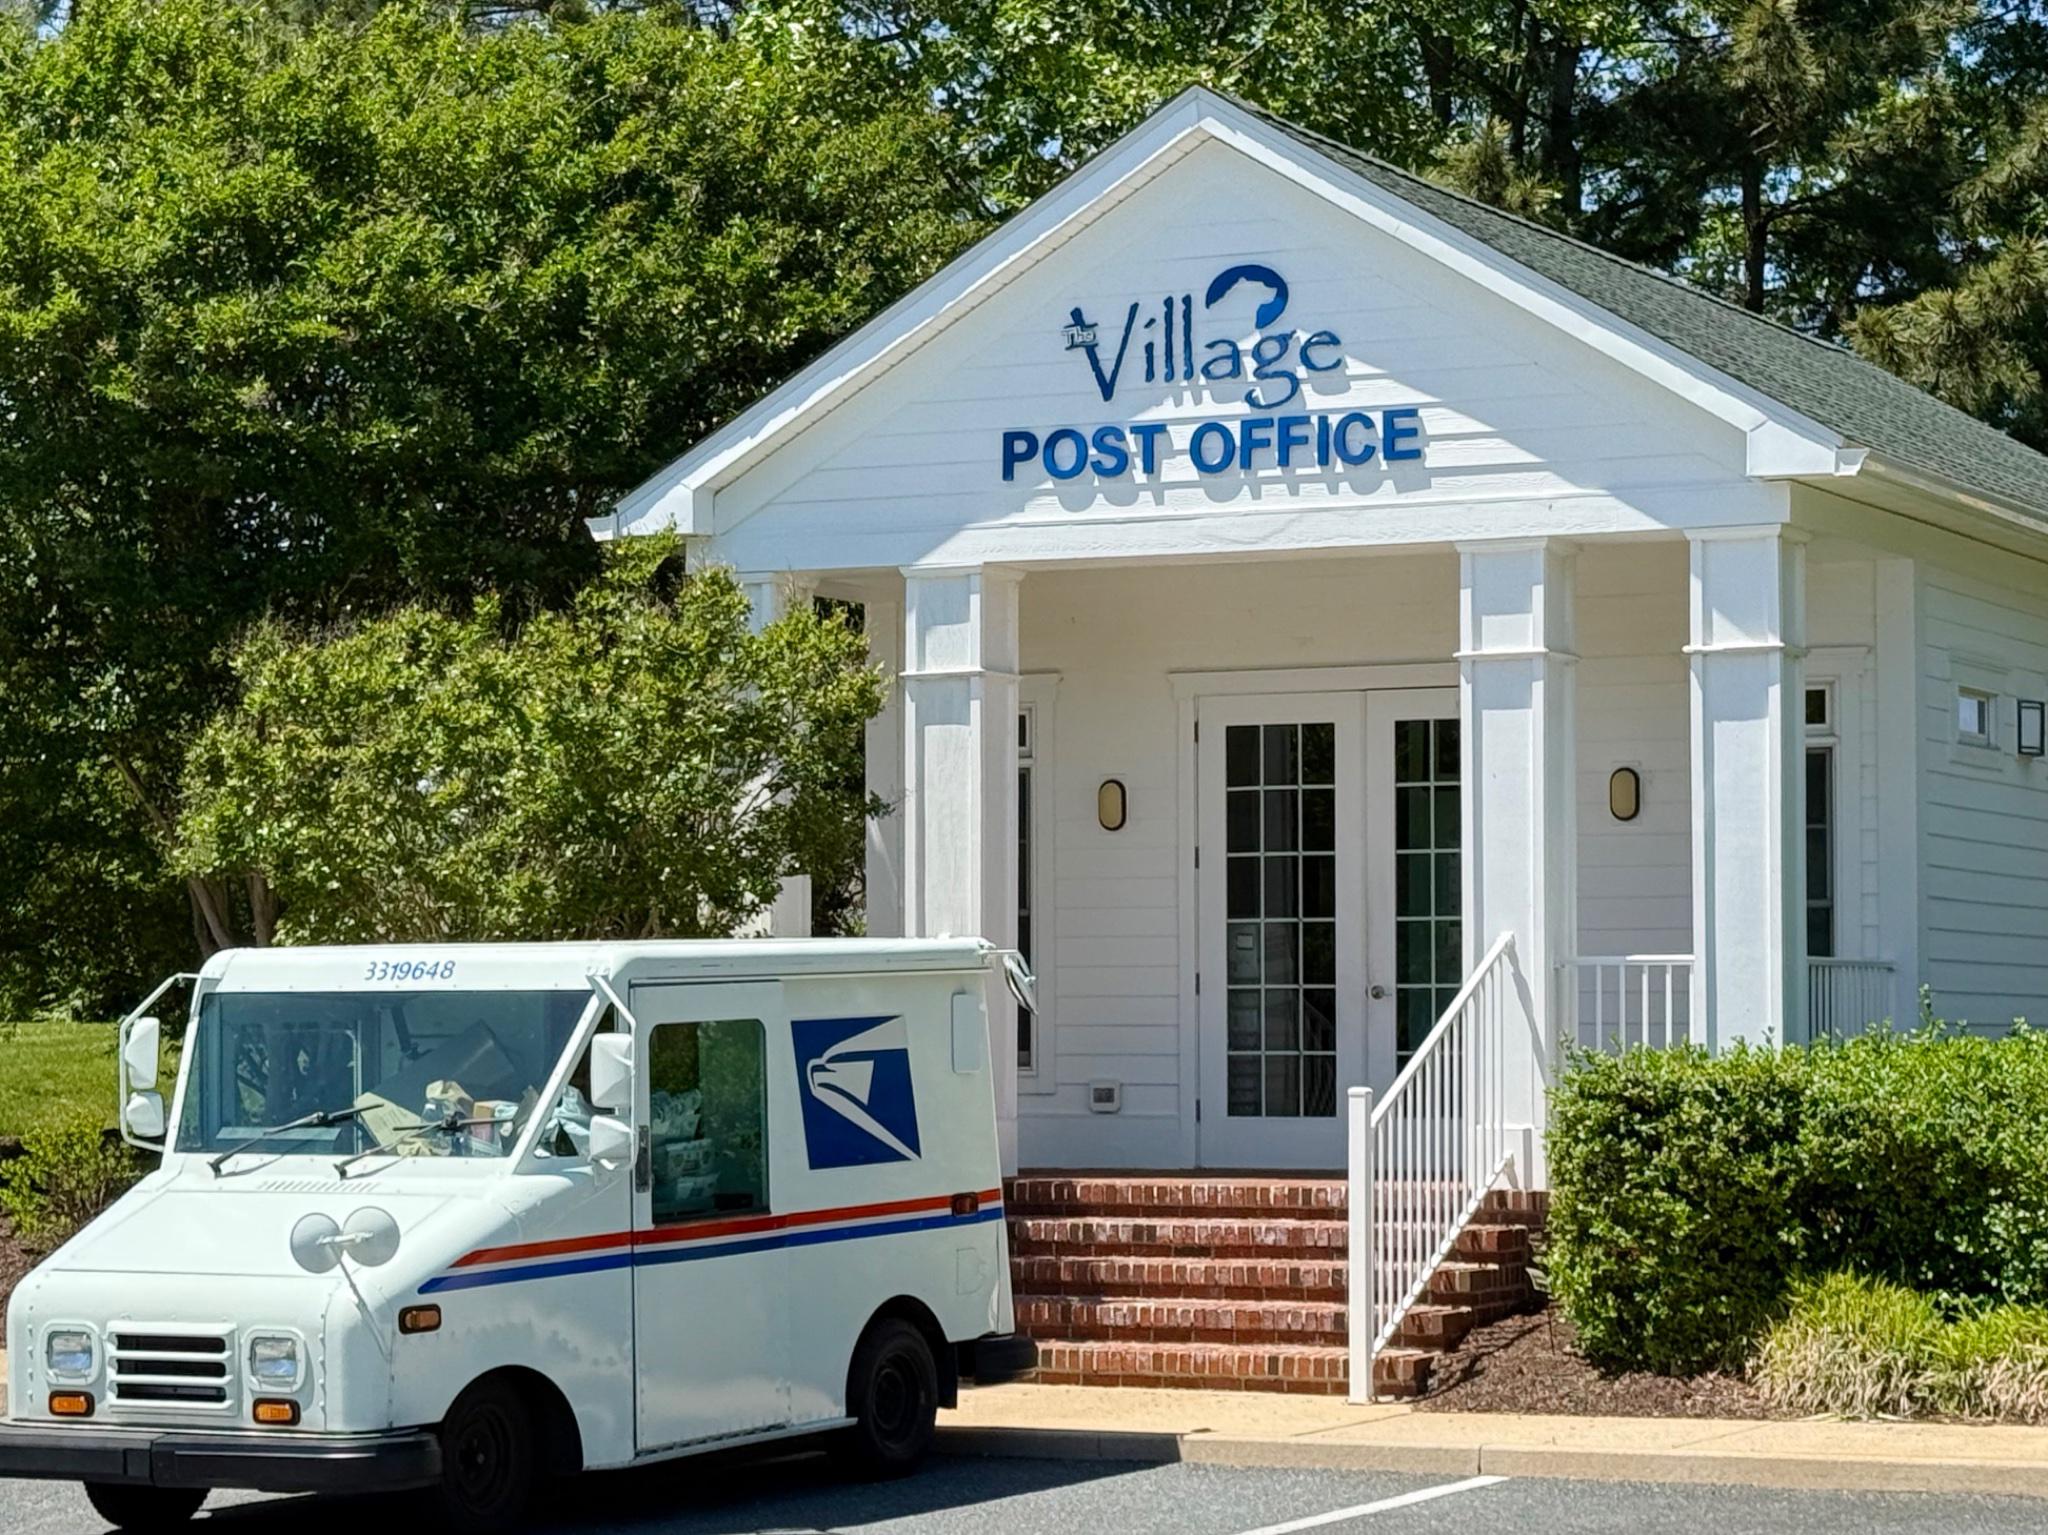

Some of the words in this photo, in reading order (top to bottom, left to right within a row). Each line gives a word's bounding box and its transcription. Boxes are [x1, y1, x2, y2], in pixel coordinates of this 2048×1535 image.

[1065, 294, 1343, 410] Village
[1002, 423, 1167, 482] POST
[1189, 409, 1422, 474] OFFICE
[364, 960, 456, 981] 3319648
